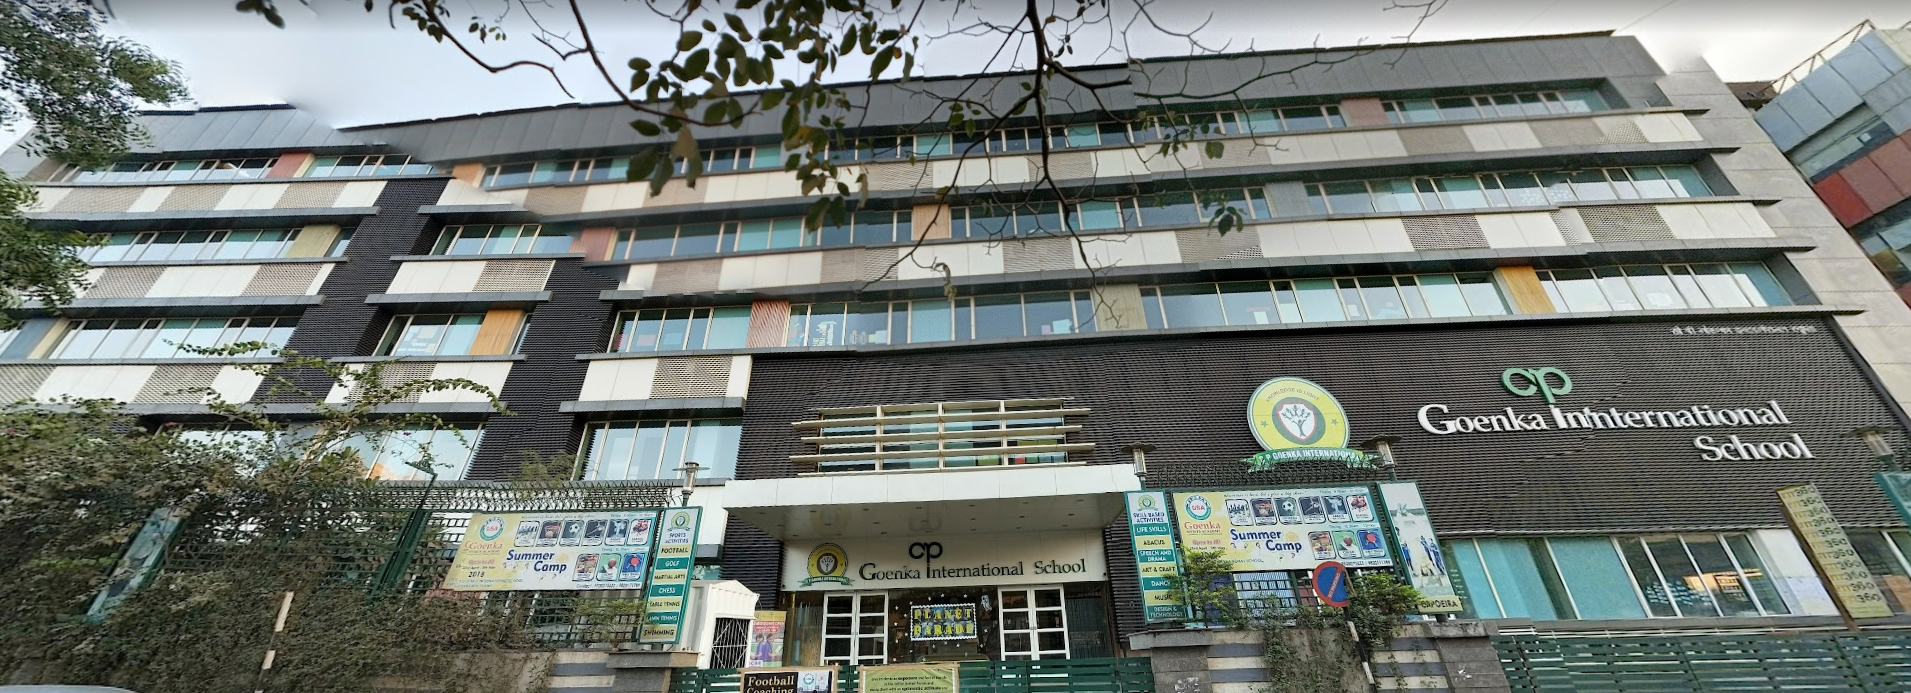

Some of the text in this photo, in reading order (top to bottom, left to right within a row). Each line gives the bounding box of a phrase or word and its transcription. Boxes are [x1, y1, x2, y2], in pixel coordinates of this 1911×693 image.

[1266, 387, 1296, 403] KNOWLEDGE
[1417, 403, 1550, 435] Goenka
[1693, 432, 1816, 461] School
[1273, 449, 1300, 459] GOENKA
[1184, 521, 1221, 530] Goenka
[1230, 529, 1281, 540] Summer
[1265, 539, 1302, 553] Camp
[506, 549, 555, 561] Summer
[533, 560, 567, 573] Camp
[859, 558, 1086, 580] Goenka International School
[1331, 573, 1341, 591] PARKING
[914, 607, 972, 620] PLANET
[643, 629, 675, 637] SWIMMING
[914, 623, 974, 636] PARADE
[748, 676, 794, 687] Football
